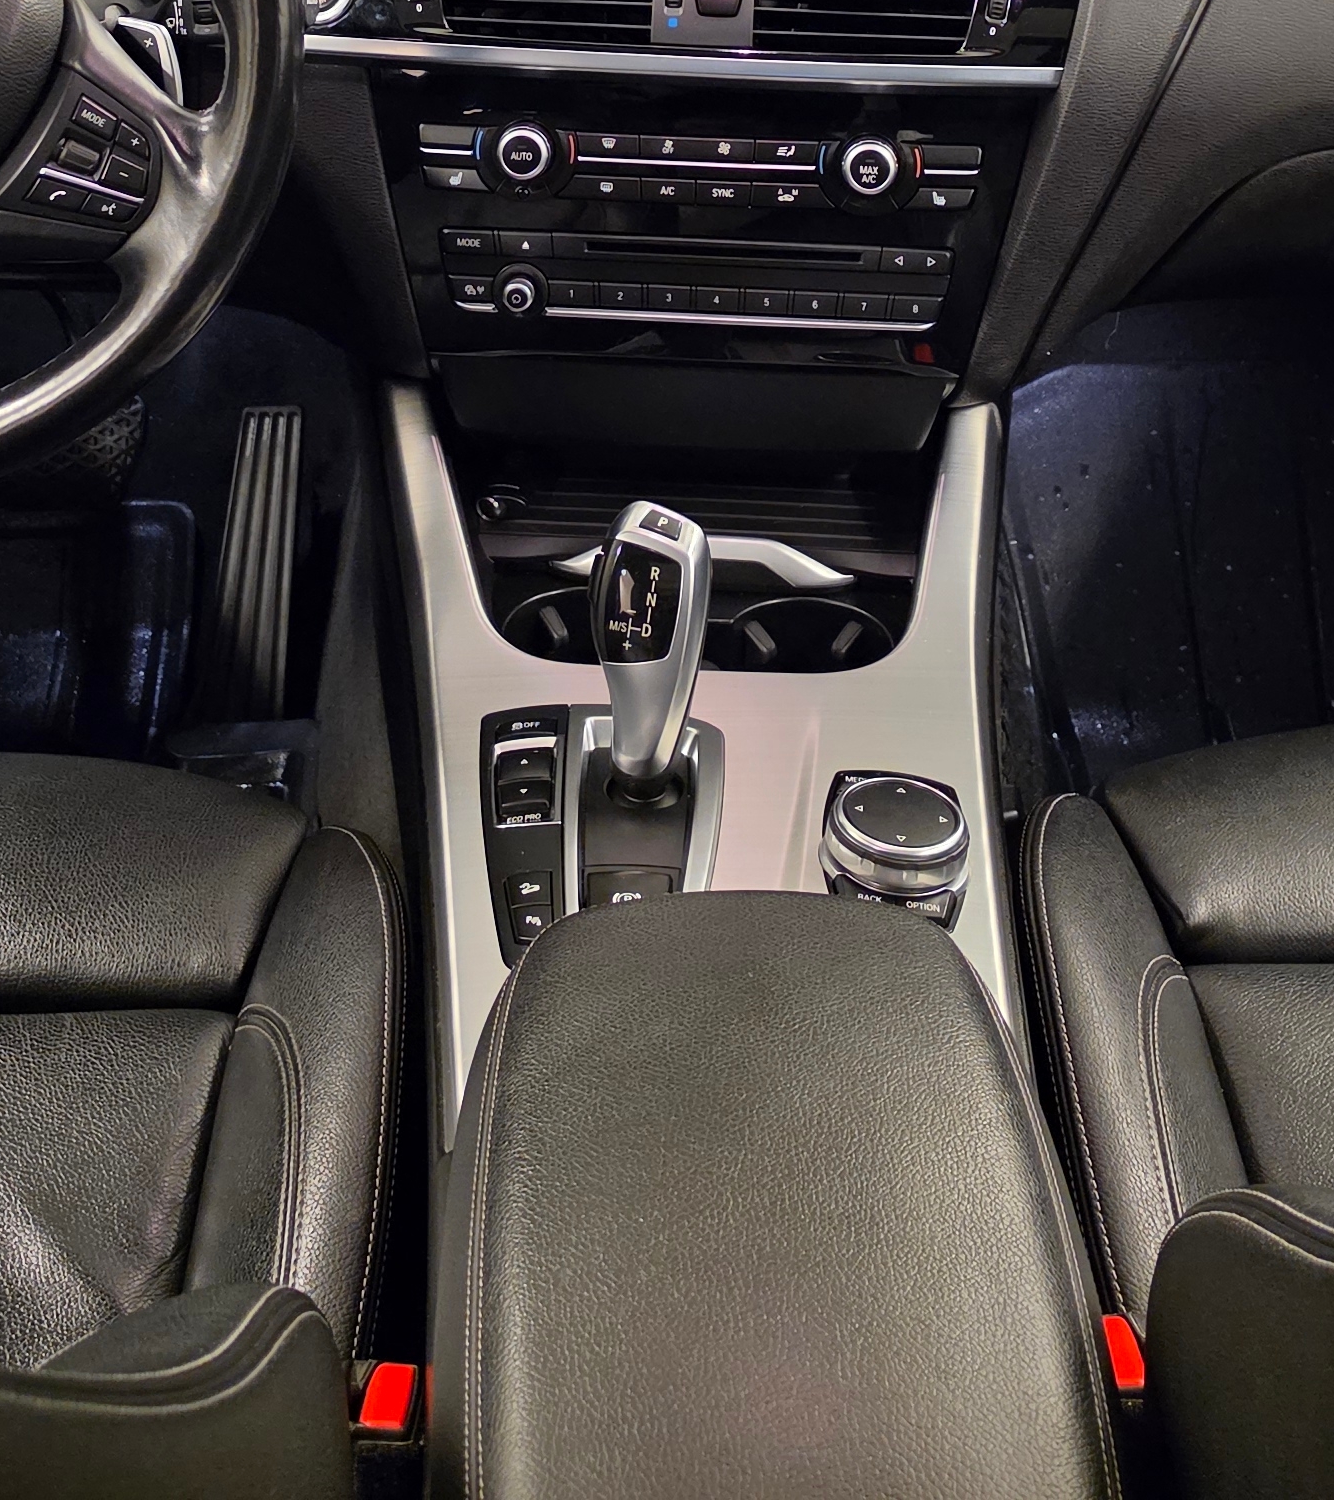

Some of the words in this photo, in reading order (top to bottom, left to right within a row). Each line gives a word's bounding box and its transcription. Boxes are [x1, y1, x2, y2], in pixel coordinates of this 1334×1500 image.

[80, 108, 107, 128] MODE
[510, 151, 533, 162] AUTO
[859, 165, 879, 175] MAX
[861, 175, 877, 184] A/C
[659, 186, 675, 197] A/C
[711, 188, 735, 198] SYNC
[456, 238, 481, 248] MODE
[569, 289, 574, 298] 1
[617, 291, 624, 301] 2
[665, 293, 672, 303] 3
[713, 295, 720, 304] 4
[763, 297, 770, 307] 5
[812, 300, 818, 310] 6
[861, 302, 867, 312] 7
[912, 304, 919, 314] 8
[657, 516, 669, 527] P
[649, 566, 661, 581] R
[645, 592, 657, 607] N
[608, 619, 627, 633] M/S
[640, 623, 652, 638] D
[524, 812, 542, 823] PRO
[857, 892, 882, 903] BACK
[905, 900, 940, 913] OPTION
